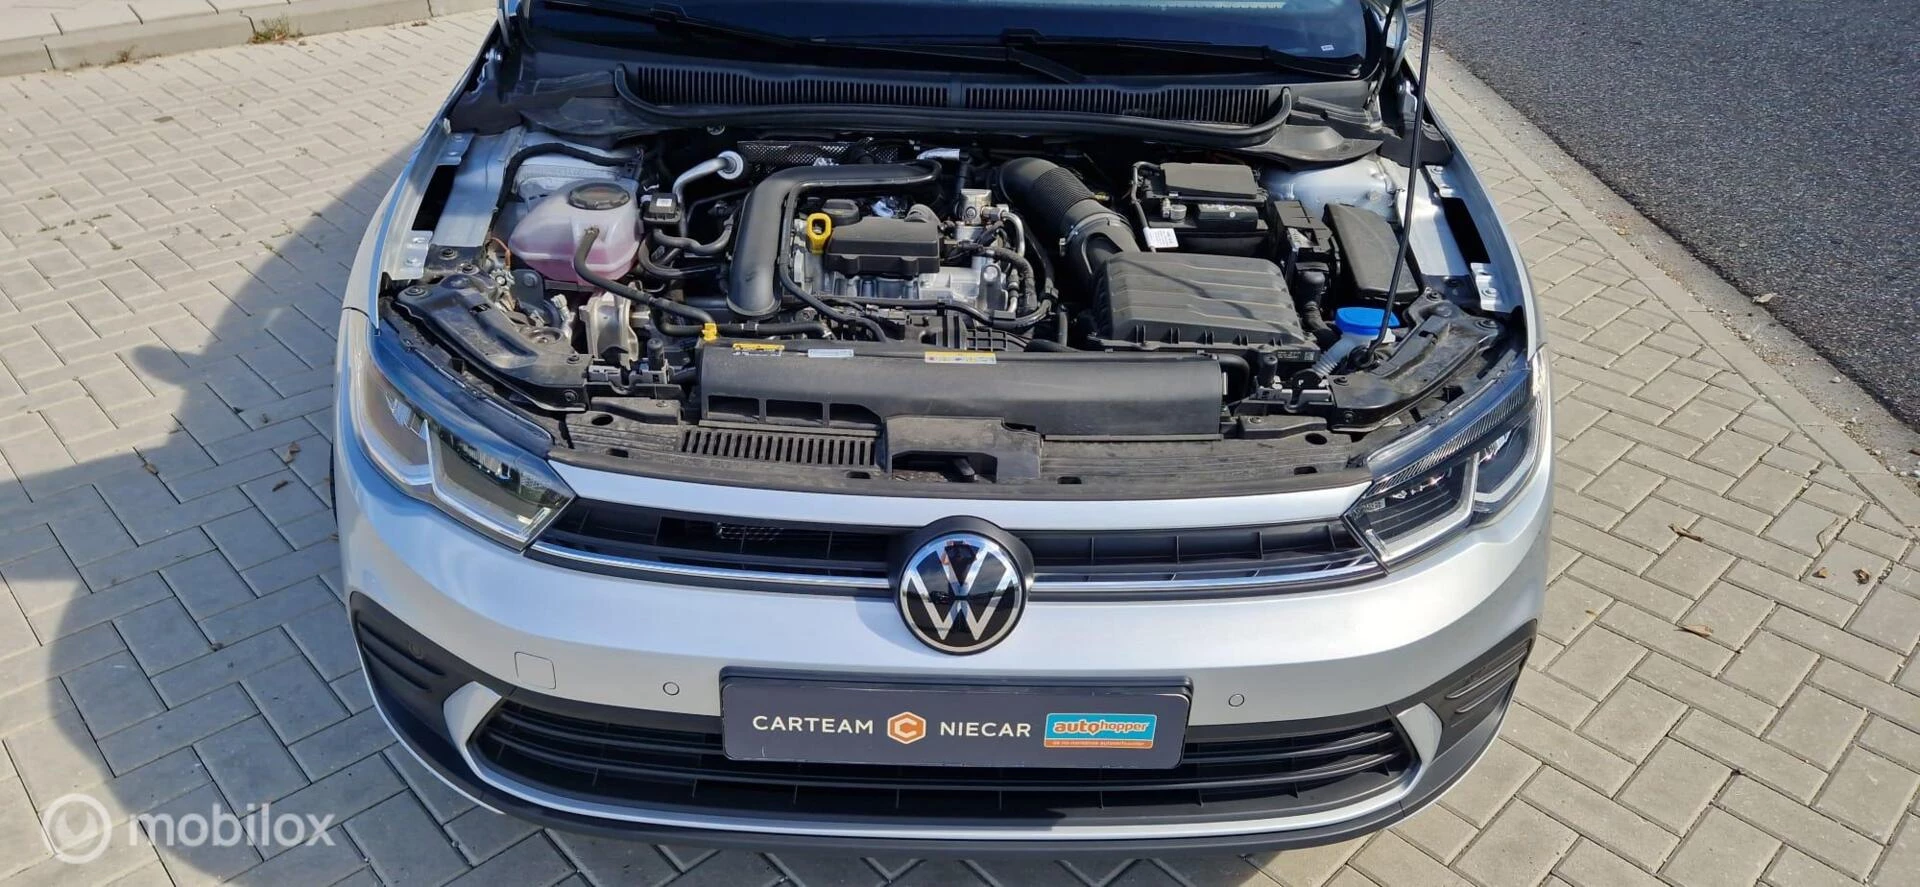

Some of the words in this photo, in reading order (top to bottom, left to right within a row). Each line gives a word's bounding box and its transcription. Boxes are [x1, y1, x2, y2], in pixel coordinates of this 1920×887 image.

[901, 534, 1022, 653] VW
[752, 715, 874, 735] CARTEAM
[940, 721, 1032, 738] NIECAR
[1053, 719, 1149, 736] autohopper
